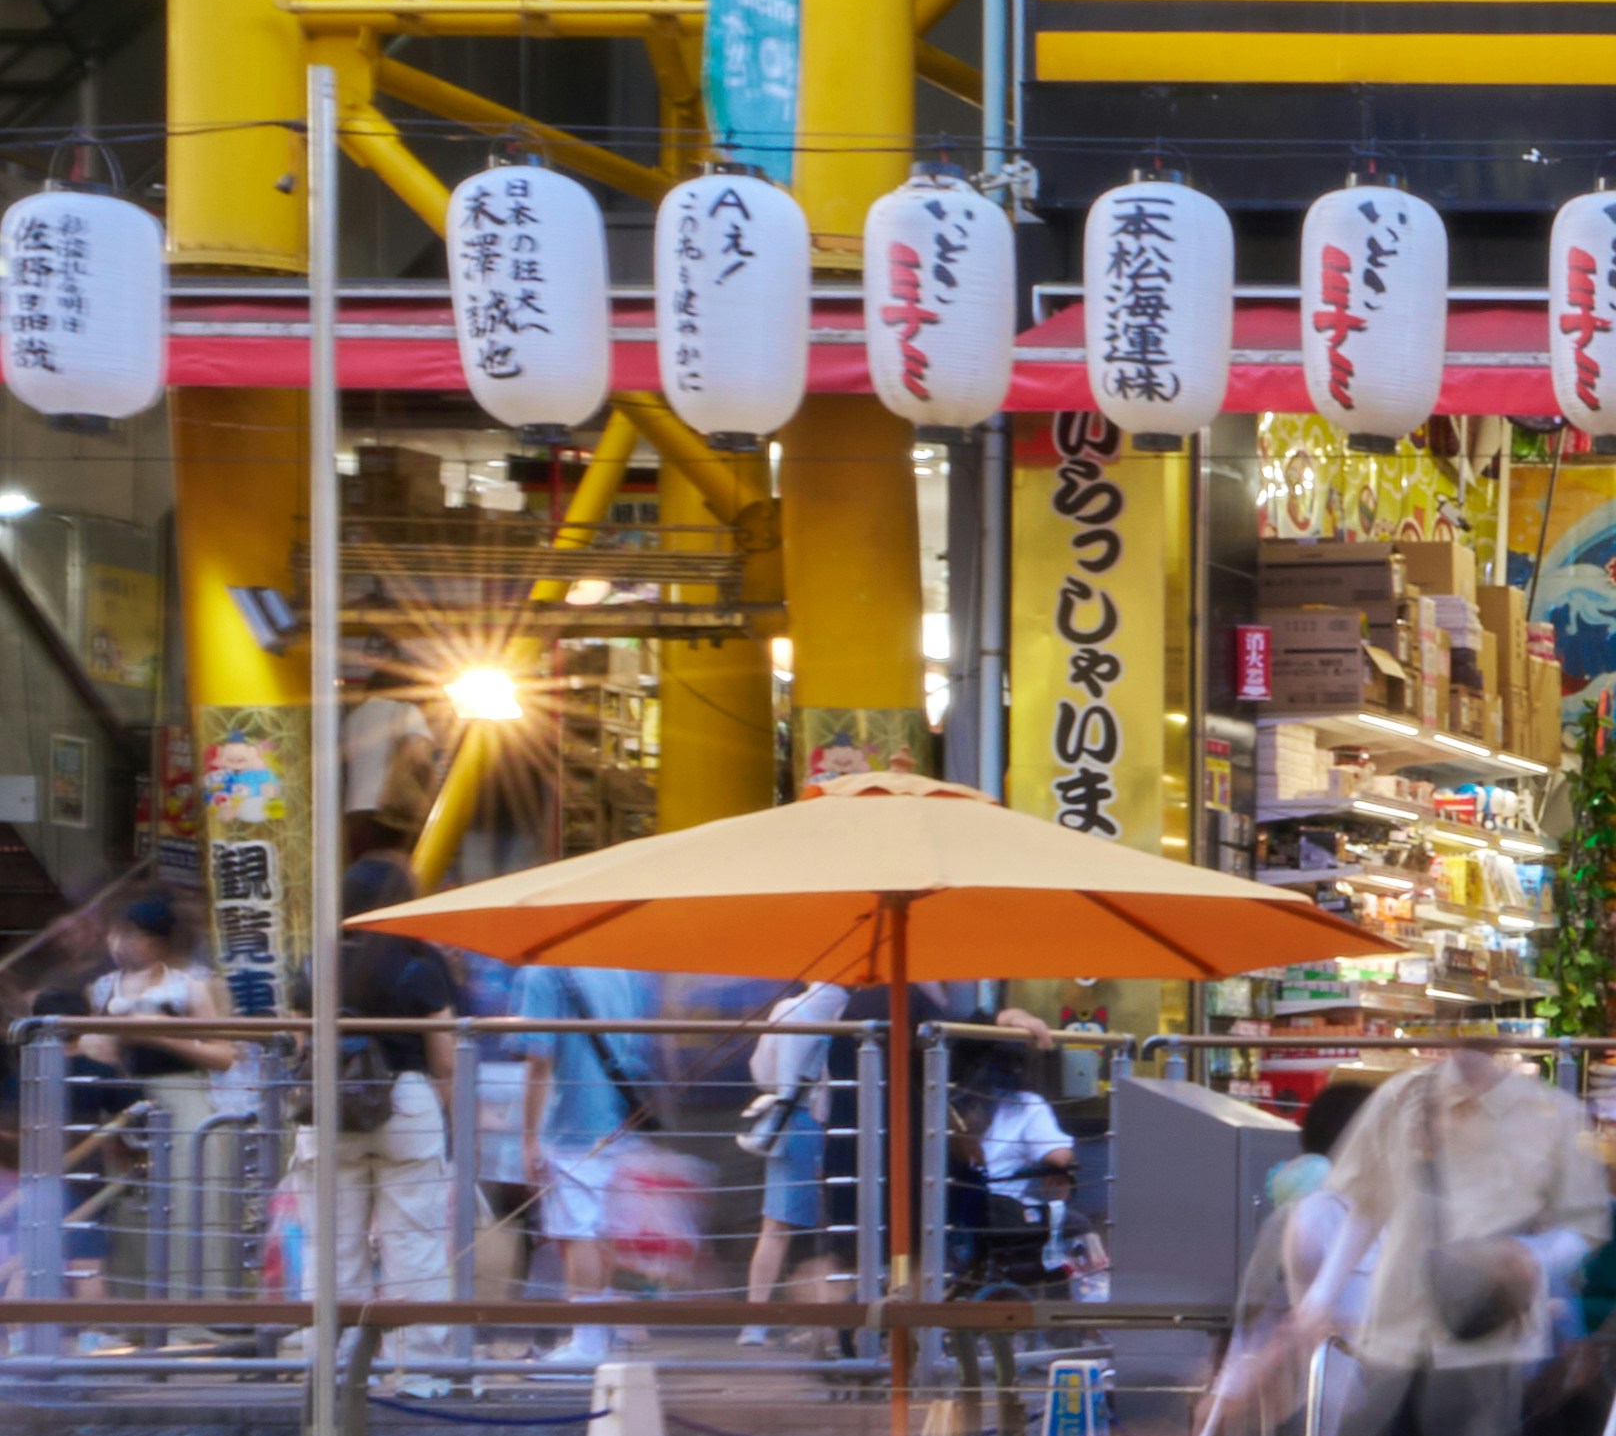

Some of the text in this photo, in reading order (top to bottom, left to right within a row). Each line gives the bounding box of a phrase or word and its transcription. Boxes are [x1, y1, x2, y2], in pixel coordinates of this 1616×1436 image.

[880, 241, 939, 401] ミナミ
[1314, 242, 1367, 410] ミナミ
[1560, 245, 1612, 411] ミナミ
